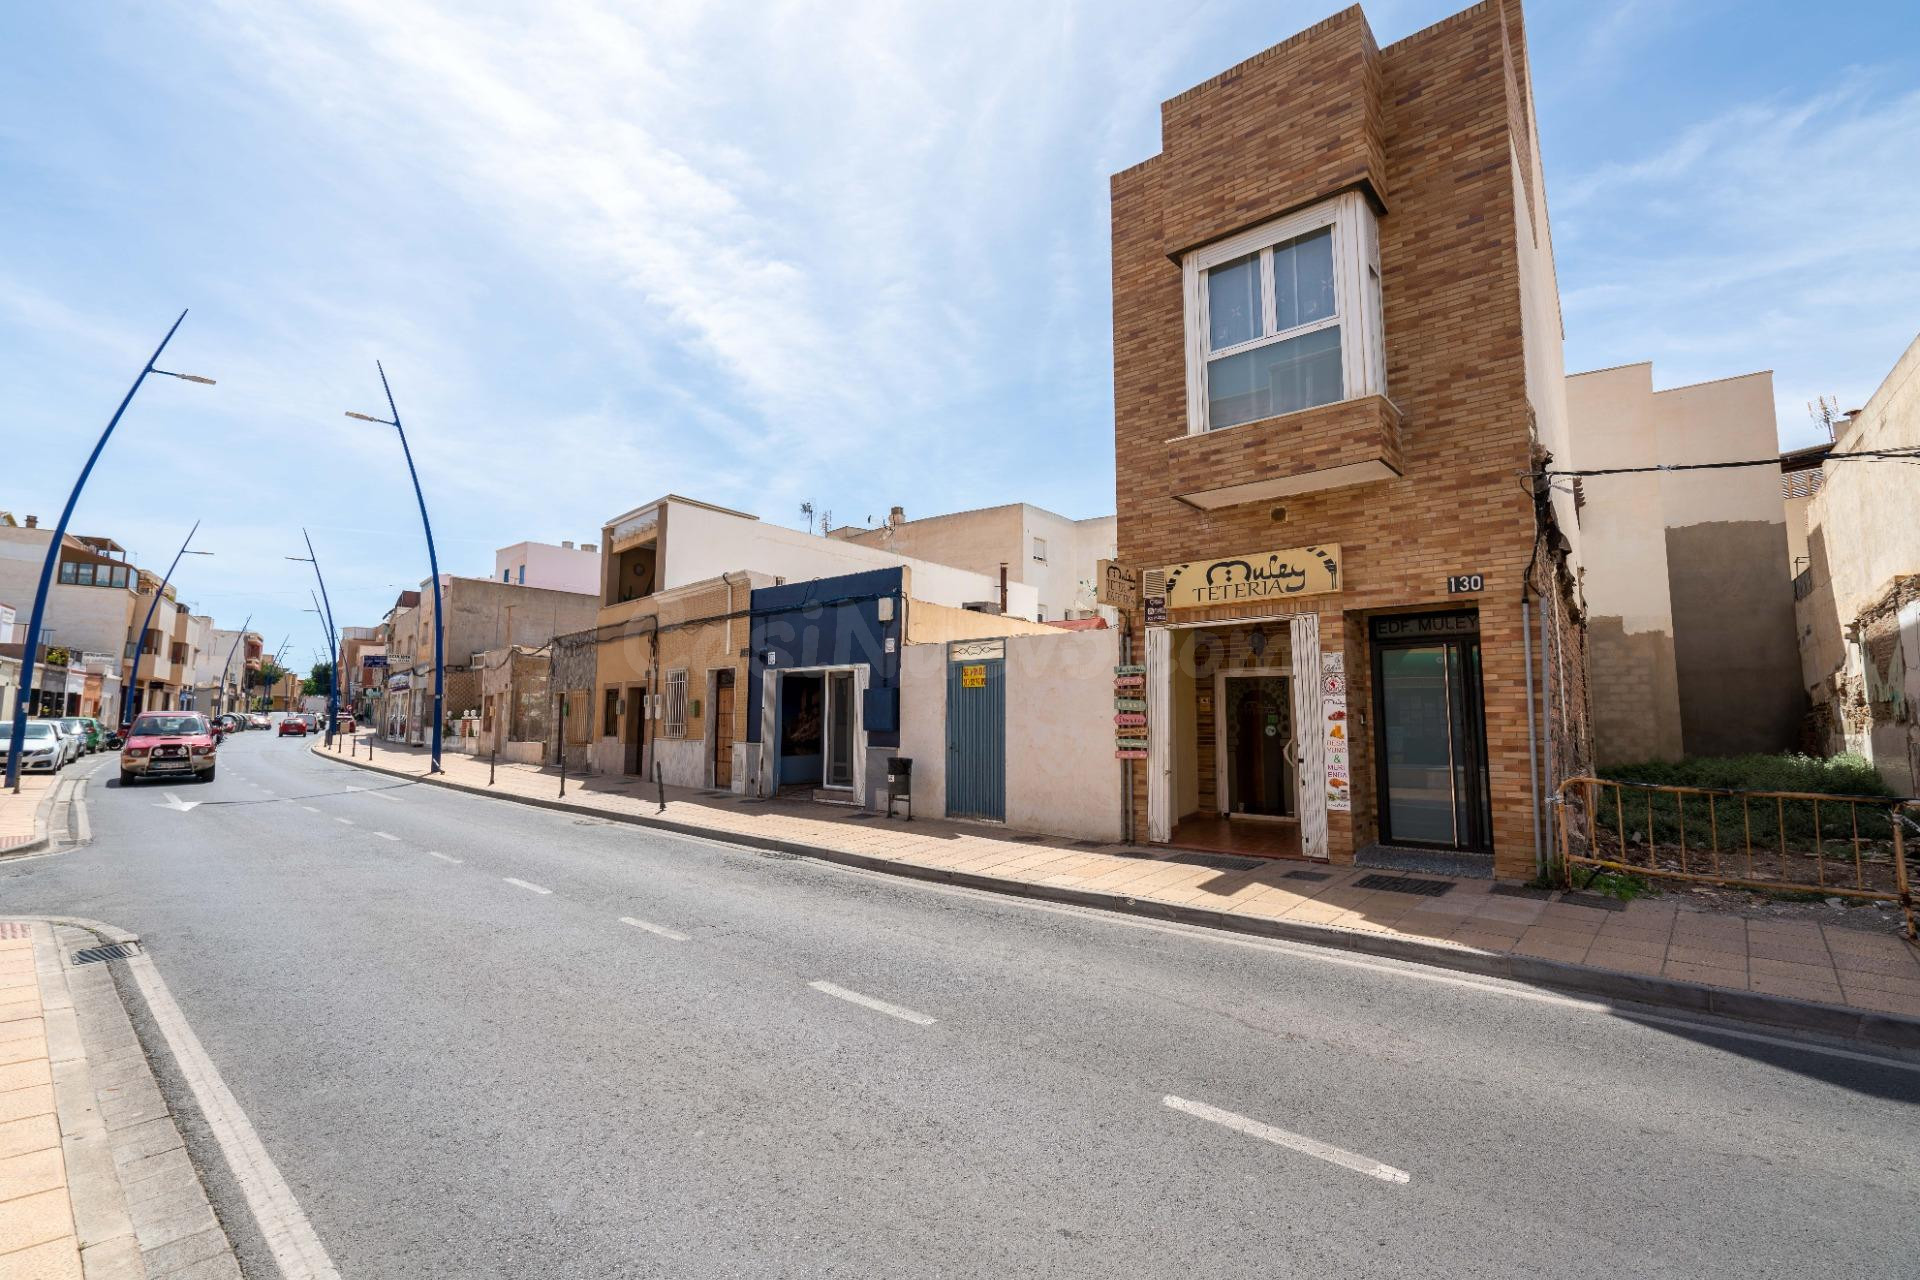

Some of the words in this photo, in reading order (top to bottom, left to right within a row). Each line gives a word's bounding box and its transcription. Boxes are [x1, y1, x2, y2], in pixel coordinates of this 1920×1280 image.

[1206, 554, 1306, 592] Muley
[1449, 575, 1482, 593] 130
[1191, 579, 1285, 603] TETERIA
[1377, 619, 1413, 635] EDF.
[1418, 614, 1479, 632] MULEY
